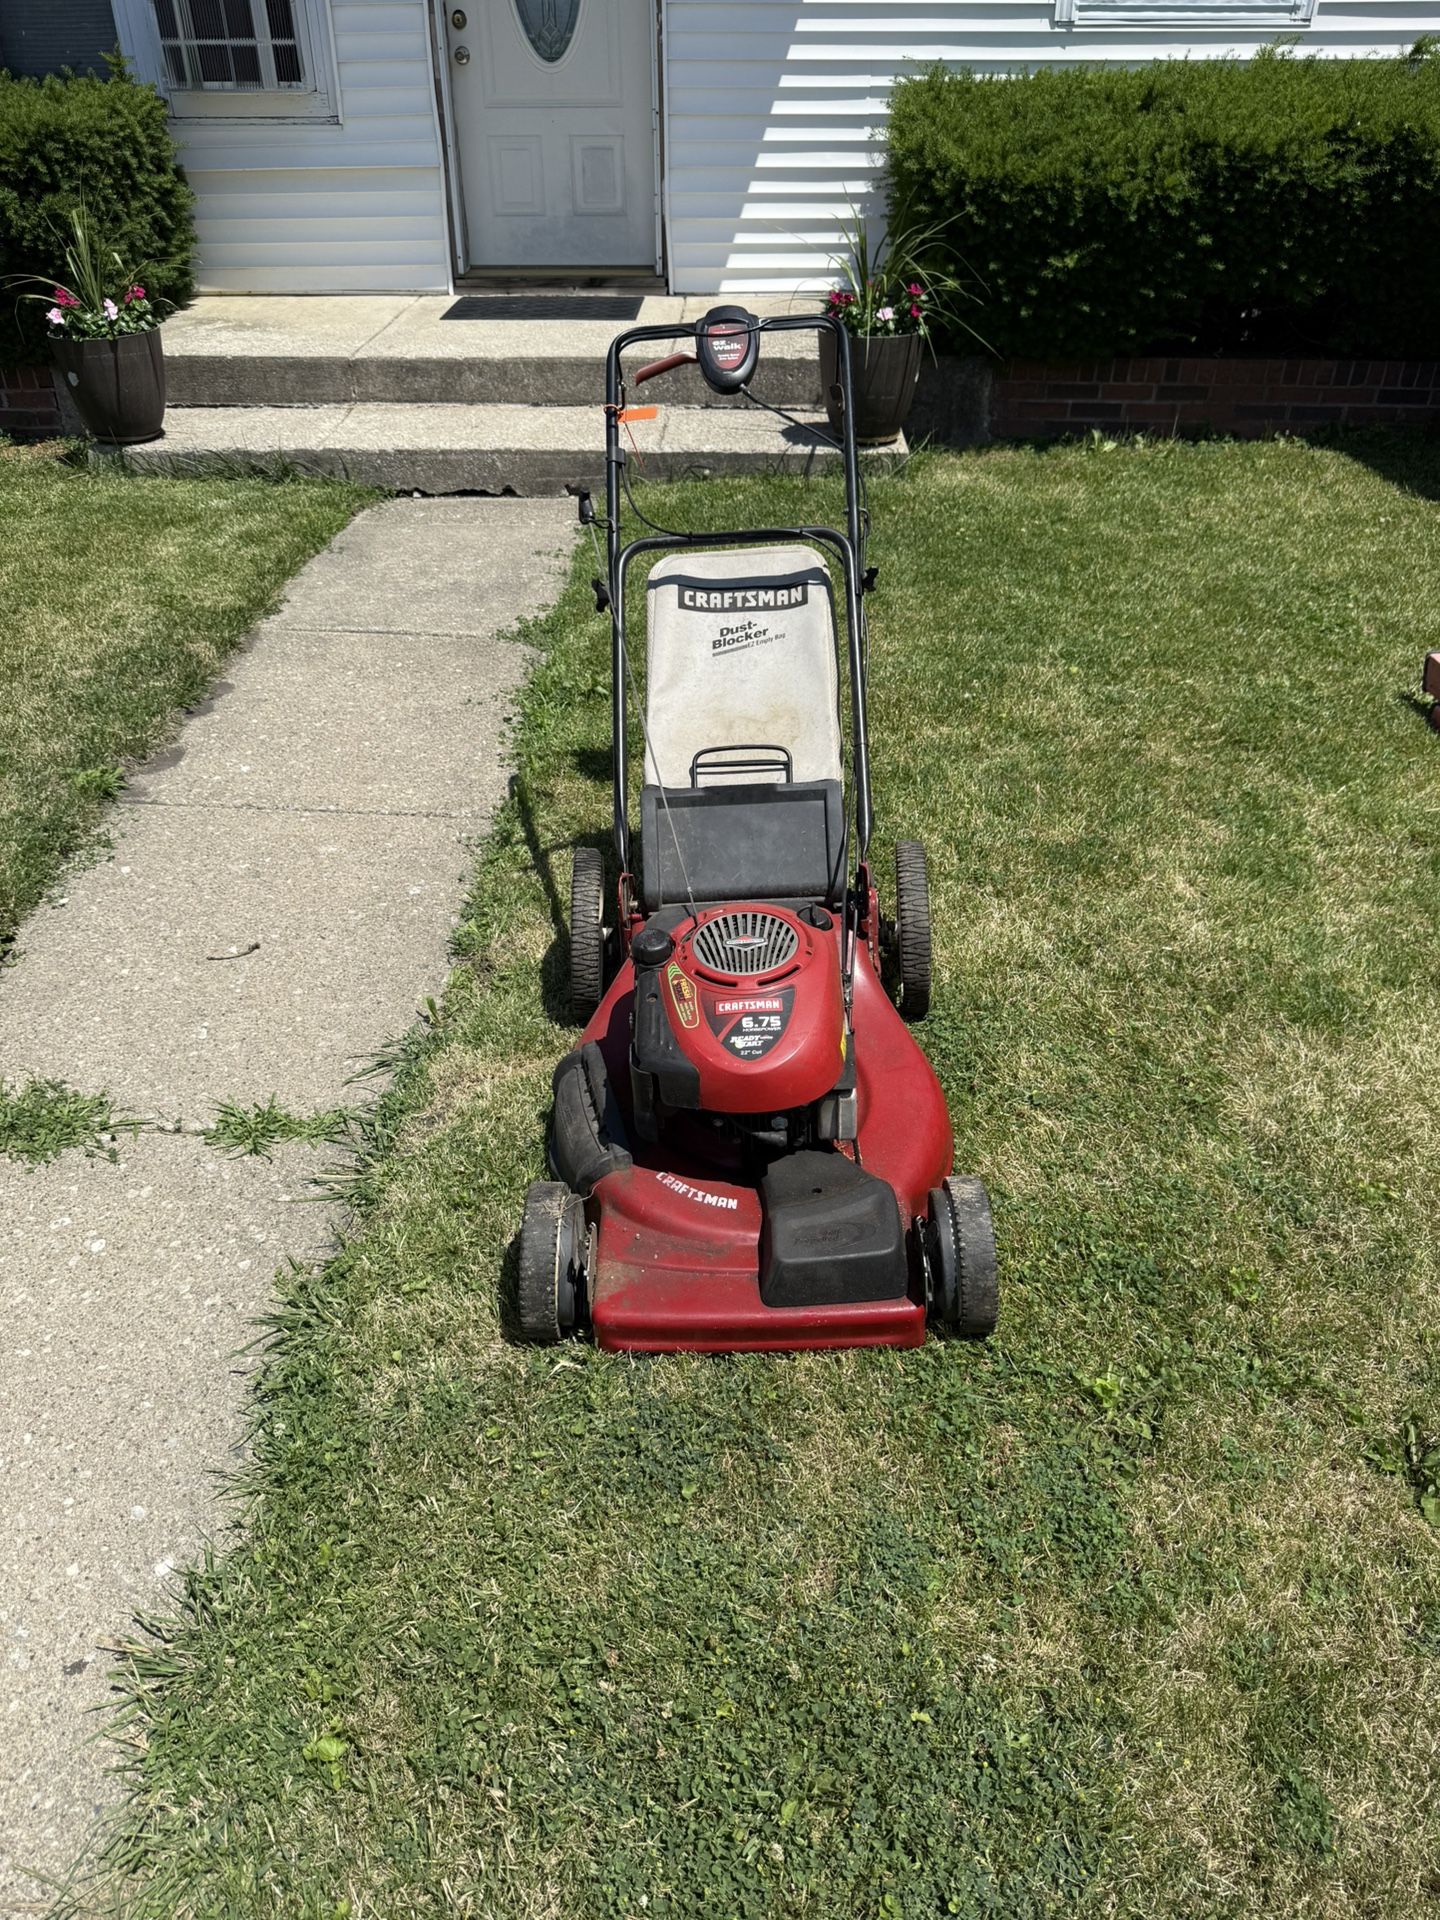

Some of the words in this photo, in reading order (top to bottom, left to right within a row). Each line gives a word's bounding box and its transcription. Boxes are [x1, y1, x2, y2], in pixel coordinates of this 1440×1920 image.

[713, 343, 742, 351] walk
[684, 585, 803, 609] CRAFTSMAN
[719, 620, 758, 638] Dust-
[774, 632, 786, 641] Bag
[711, 628, 769, 650] Blocker
[718, 1000, 780, 1012] CRAFTSMAN
[741, 1015, 782, 1028] 6.75
[656, 1171, 738, 1210] CRAFTSMAN
